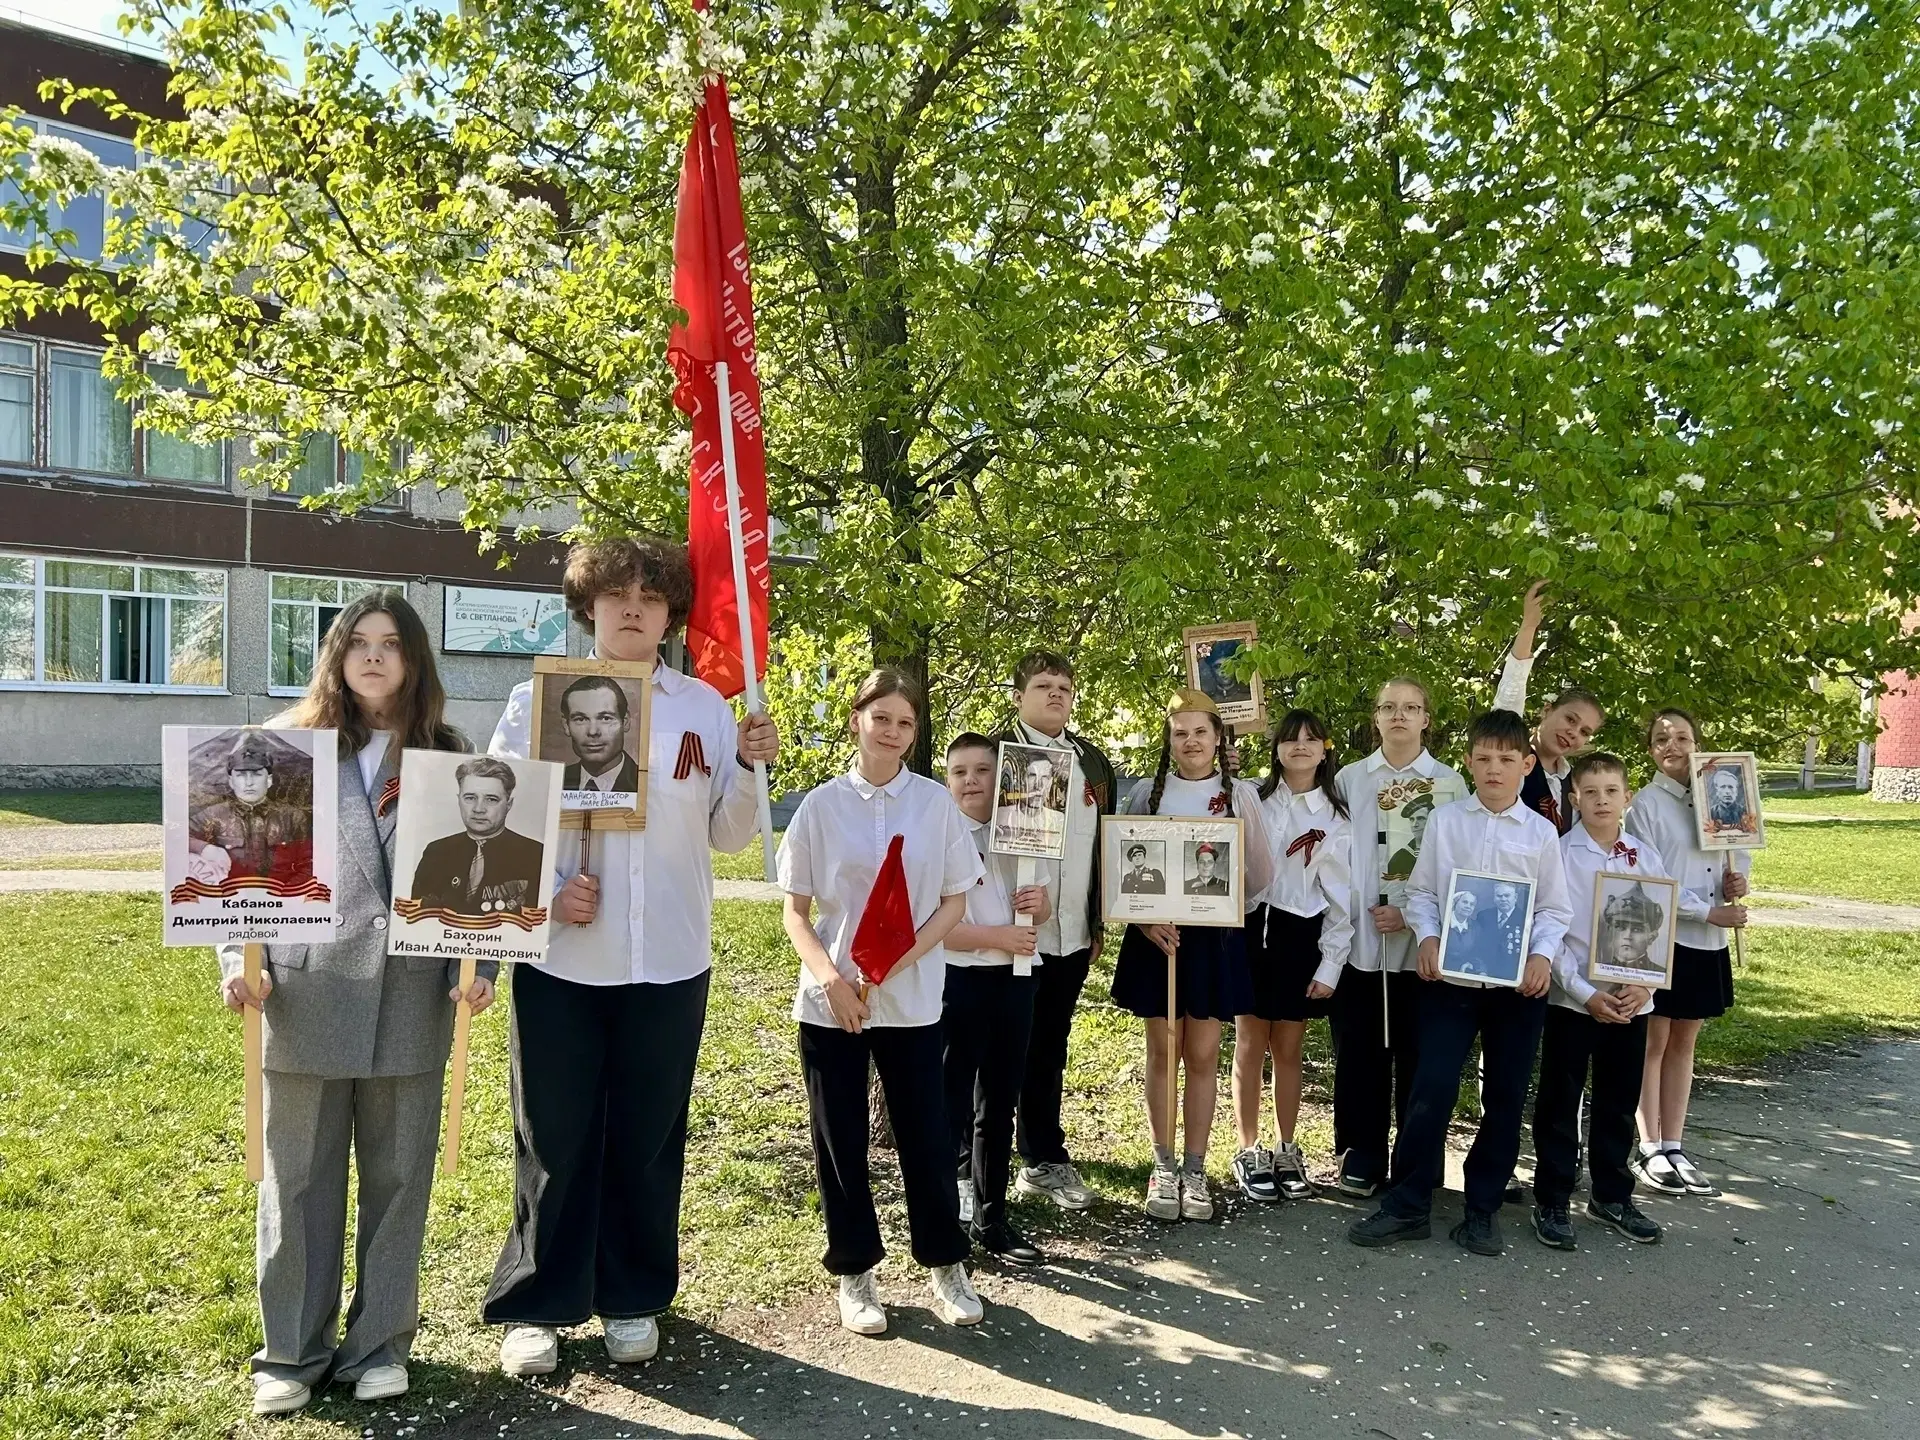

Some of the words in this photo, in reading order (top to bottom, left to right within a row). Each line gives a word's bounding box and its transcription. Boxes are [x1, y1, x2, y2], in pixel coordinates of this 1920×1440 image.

[455, 612, 469, 620] Е.Ф.
[469, 613, 518, 623] СВЕТЛАНОВА
[221, 899, 284, 909] Кабанов
[172, 915, 239, 928] Дмитрий
[243, 915, 332, 925] Николаевич
[227, 928, 279, 940] рядовой
[443, 929, 502, 943] Бахорин
[394, 939, 430, 953] Иван
[433, 942, 541, 960] Александрович
